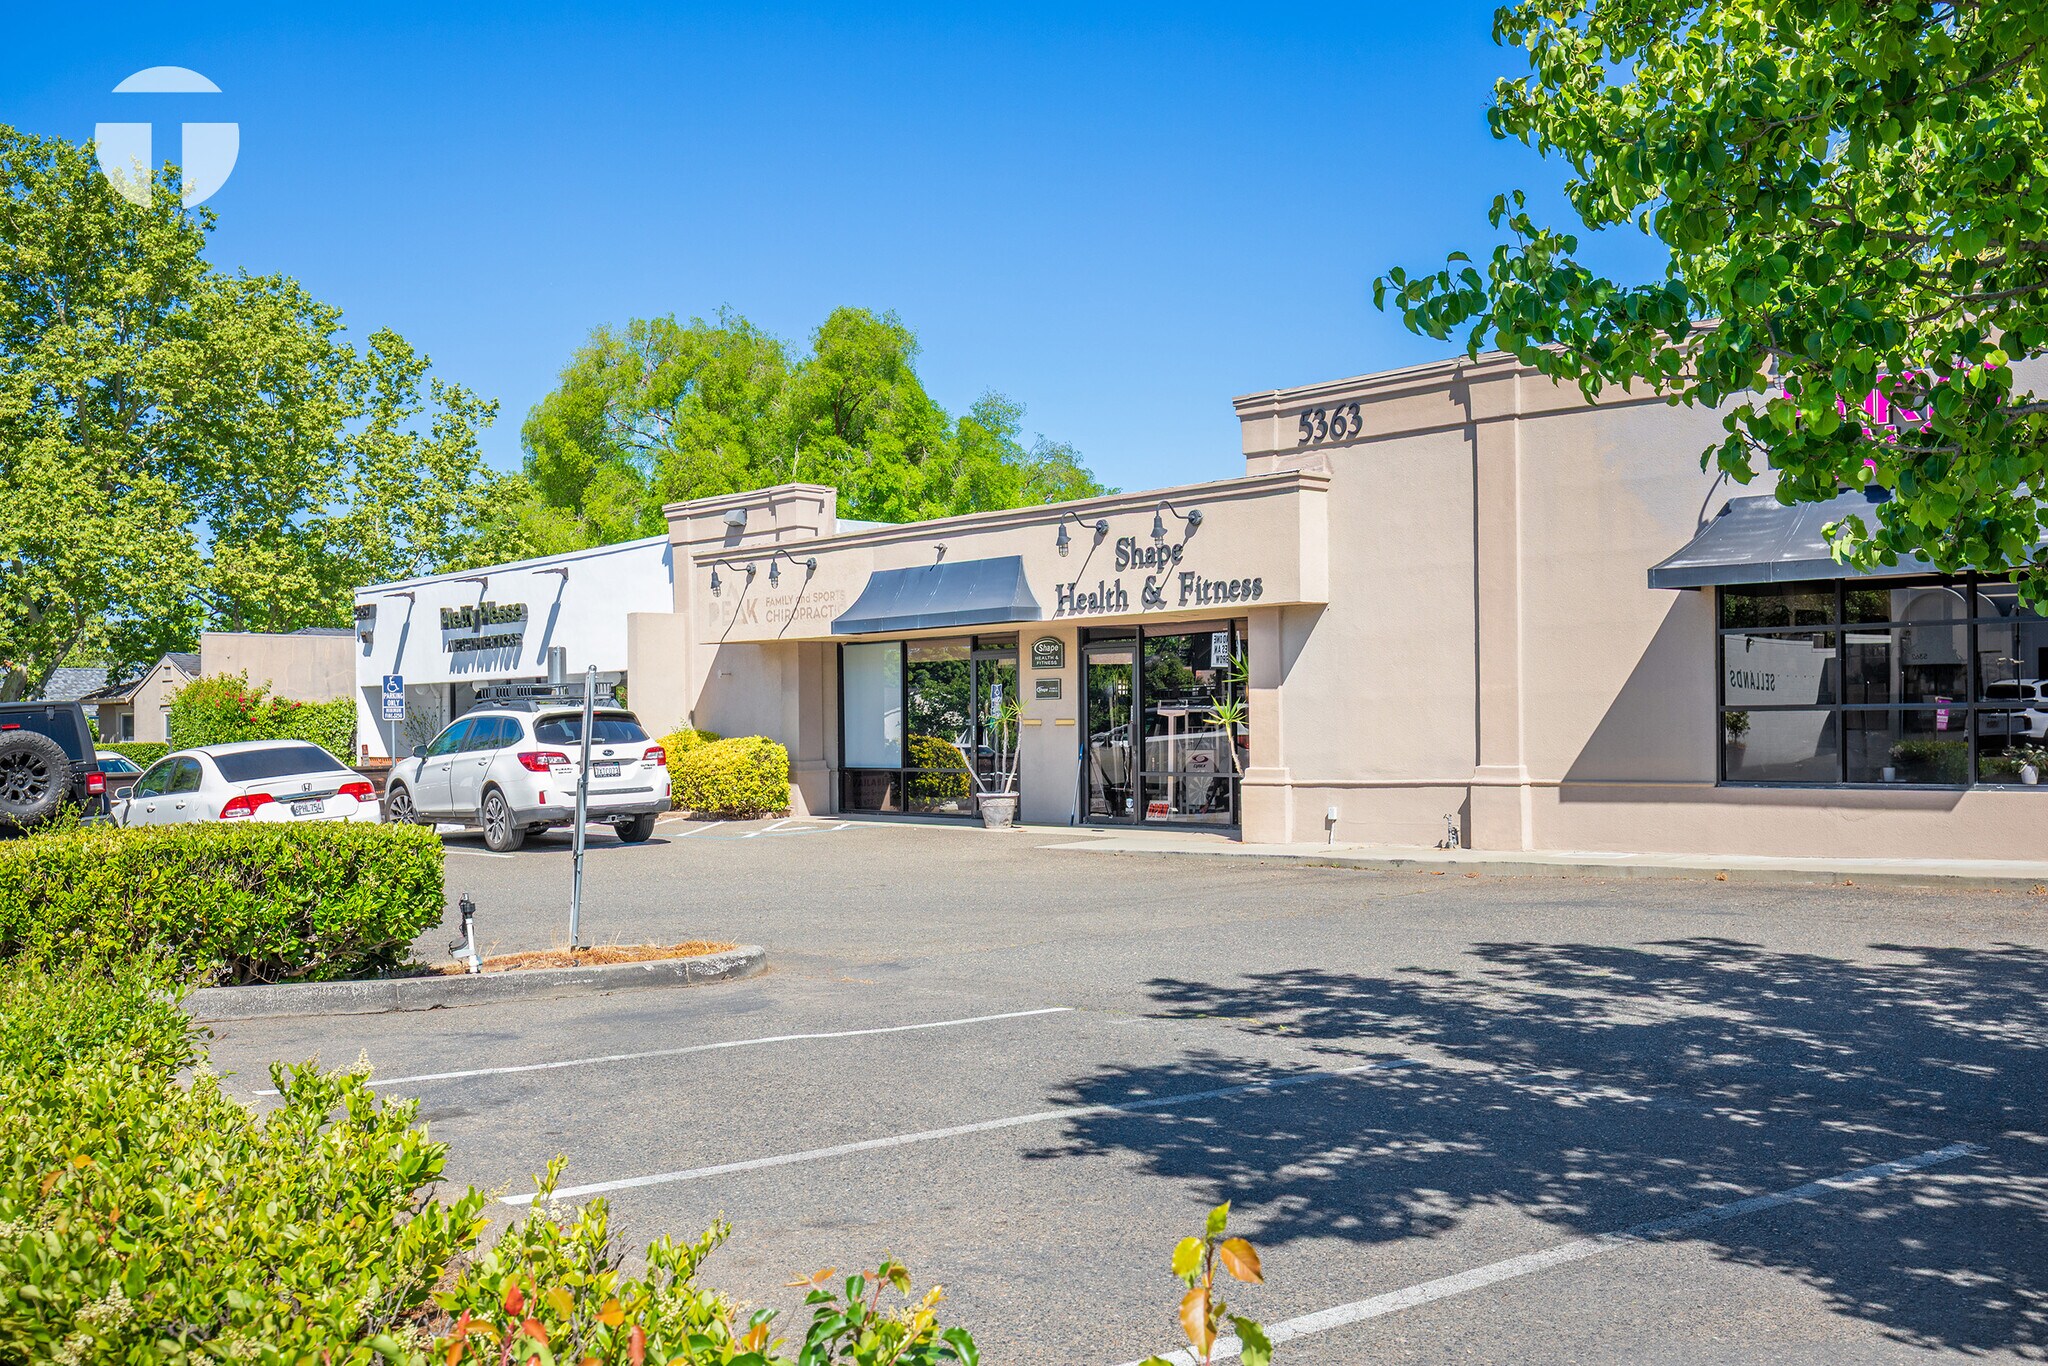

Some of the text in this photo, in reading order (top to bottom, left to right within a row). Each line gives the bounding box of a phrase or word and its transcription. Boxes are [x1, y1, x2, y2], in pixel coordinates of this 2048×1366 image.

[1299, 402, 1363, 442] 5363
[1115, 536, 1184, 573] Shape
[765, 595, 794, 607] FAMILY
[813, 590, 845, 602] SPORTS
[1055, 571, 1263, 615] Health & Fitness
[1038, 644, 1059, 653] Shape
